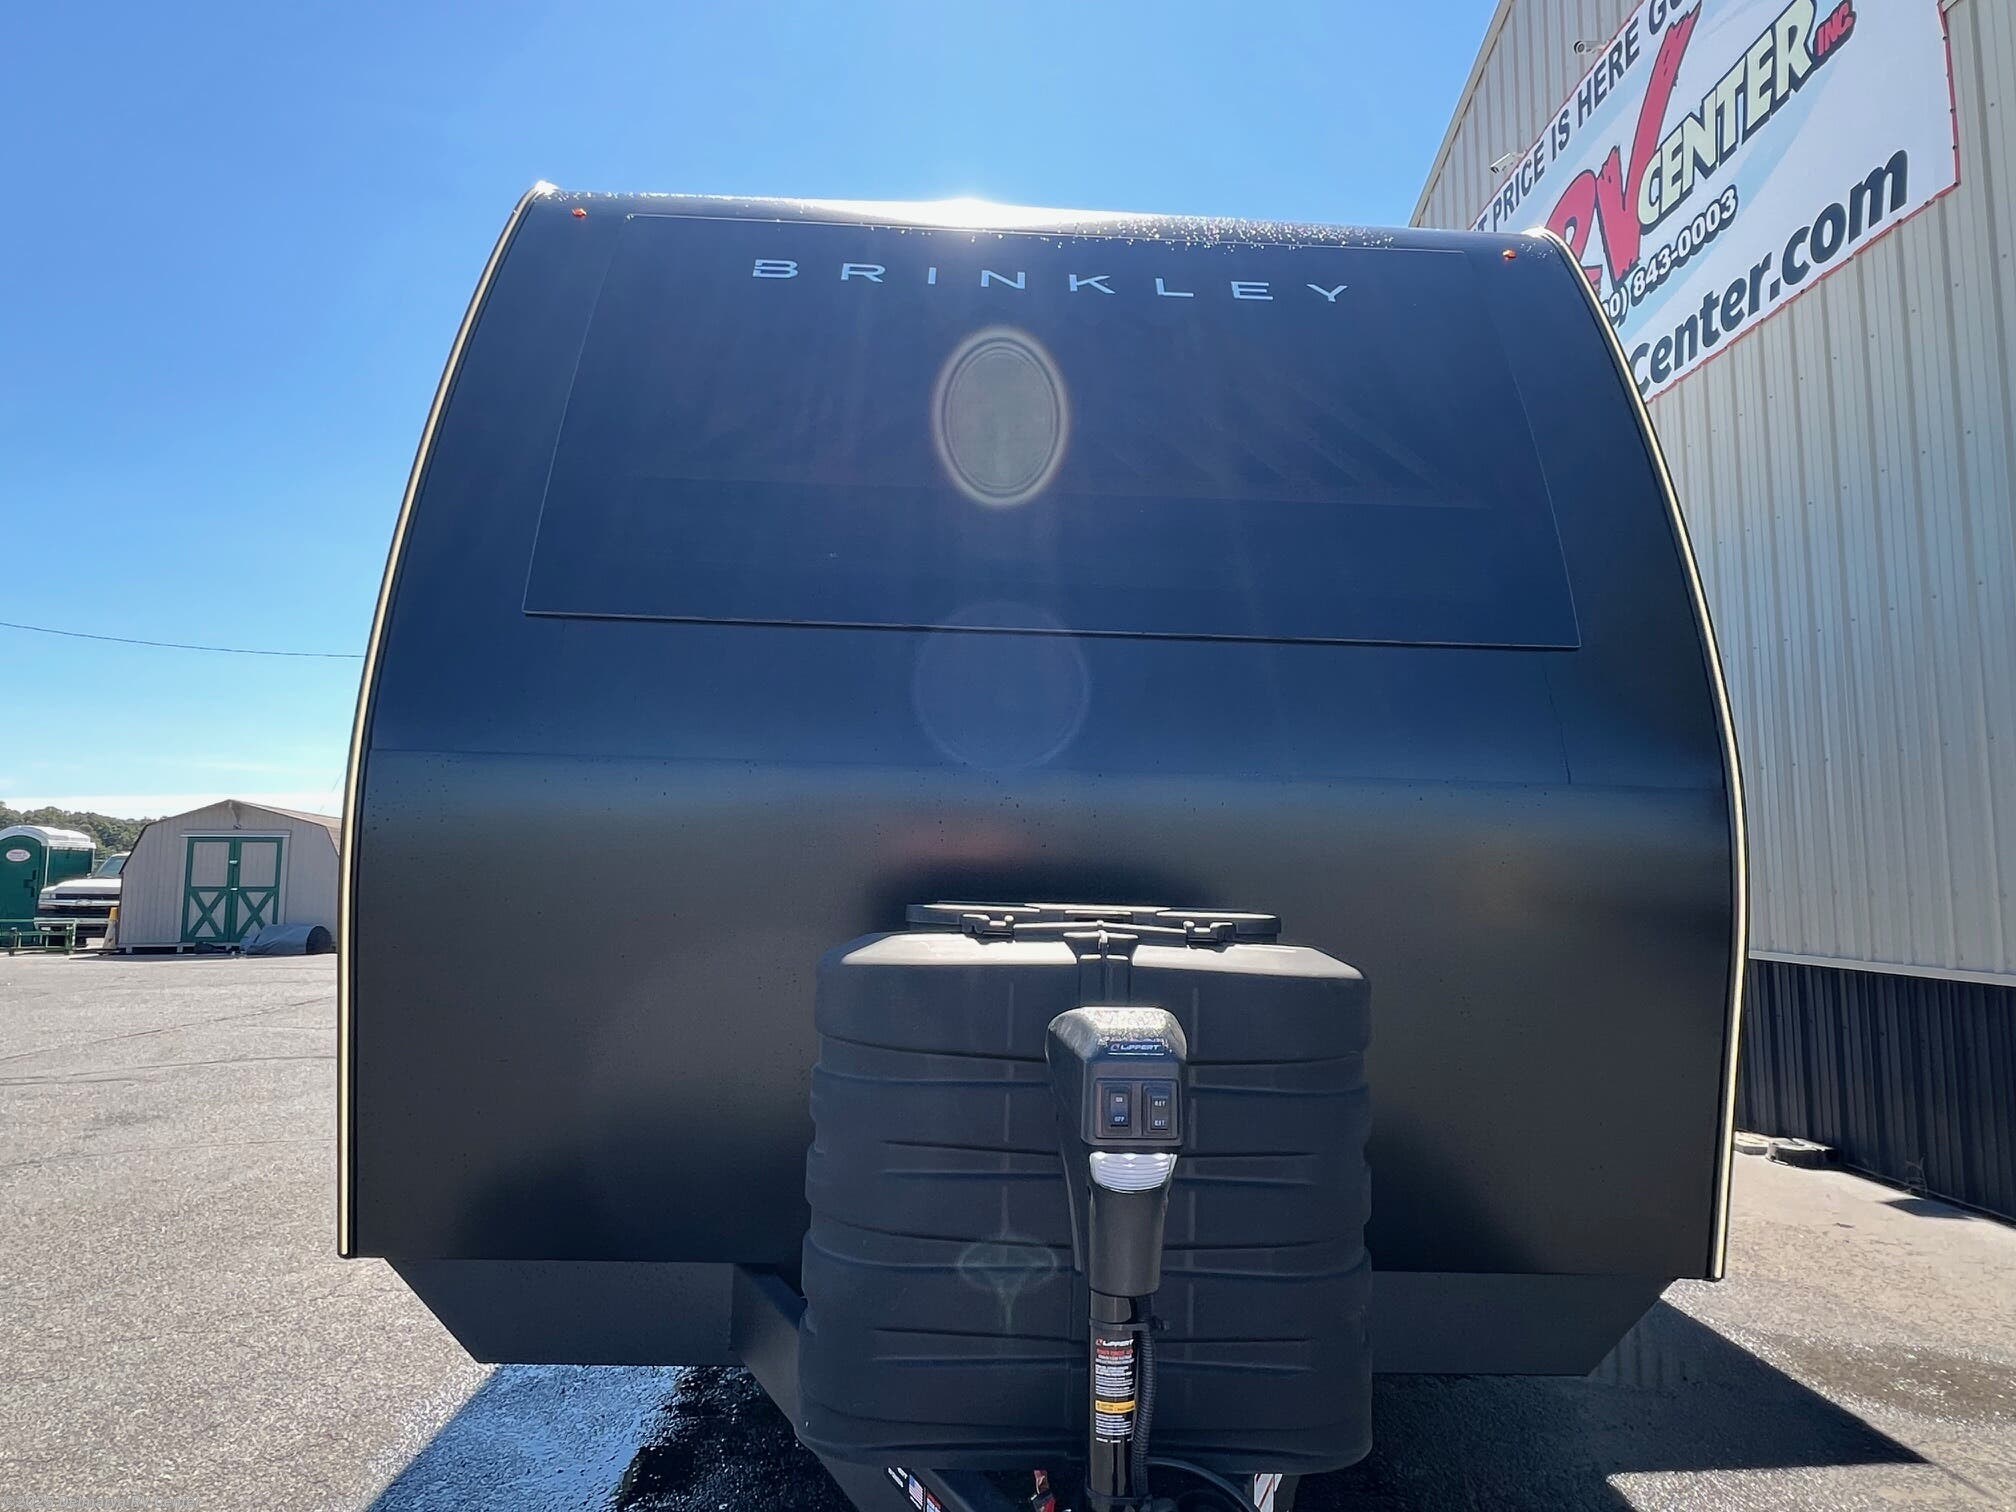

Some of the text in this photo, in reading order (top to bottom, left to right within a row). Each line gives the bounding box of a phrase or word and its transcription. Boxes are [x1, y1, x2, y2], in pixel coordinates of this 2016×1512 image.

[1493, 140, 1546, 231] PRICE
[1552, 109, 1570, 161] IS
[1577, 16, 1640, 128] HERE
[1637, 0, 1815, 230] CENTER
[751, 258, 1349, 302] BRINKLEY
[1631, 187, 1737, 302] 843-0003
